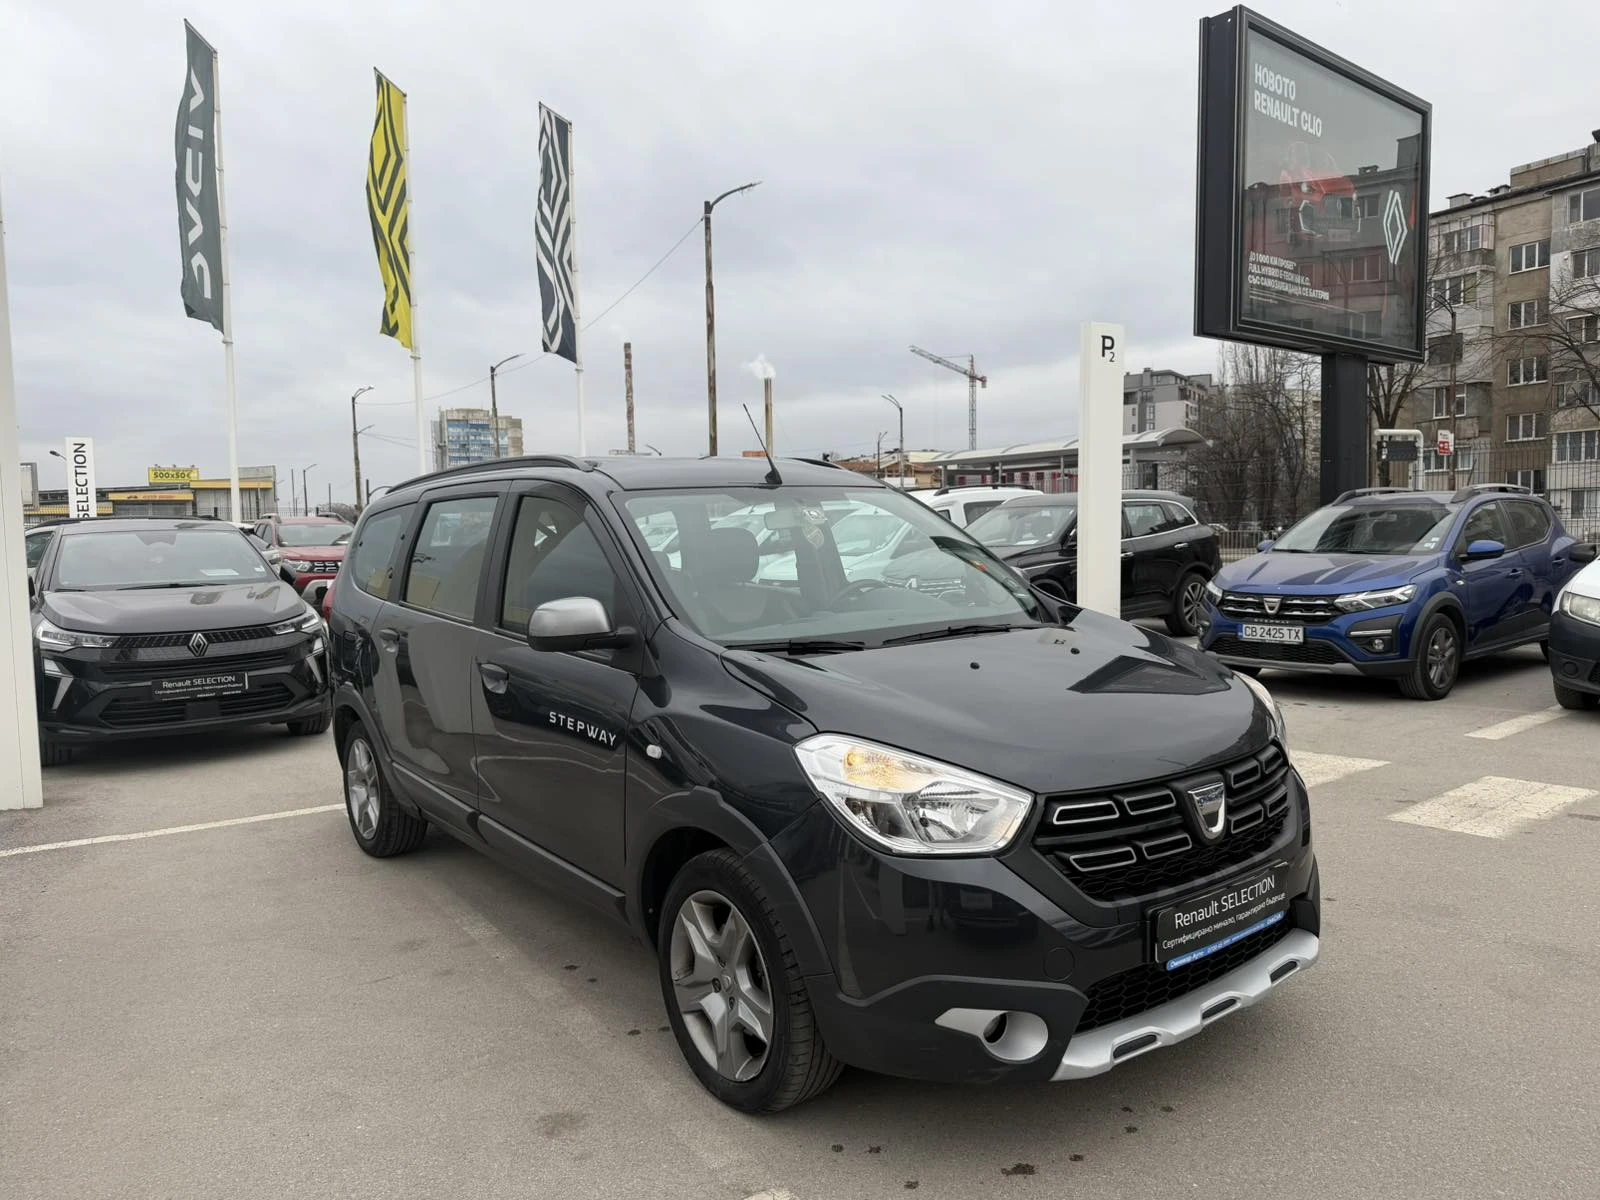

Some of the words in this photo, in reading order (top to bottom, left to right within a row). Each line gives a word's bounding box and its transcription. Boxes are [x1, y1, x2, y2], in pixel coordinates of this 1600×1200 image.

[1254, 63, 1296, 101] НОВОТО
[1254, 89, 1299, 128] RENAULT
[1301, 110, 1322, 137] CLIO
[1245, 626, 1257, 637] CB
[1259, 627, 1284, 639] 2425
[1287, 629, 1300, 640] TX
[162, 679, 191, 689] Renault
[192, 675, 235, 685] SELECTION
[549, 711, 616, 746] STEPWAY
[1174, 900, 1219, 929] Renault
[1221, 874, 1275, 912] SELECTION
